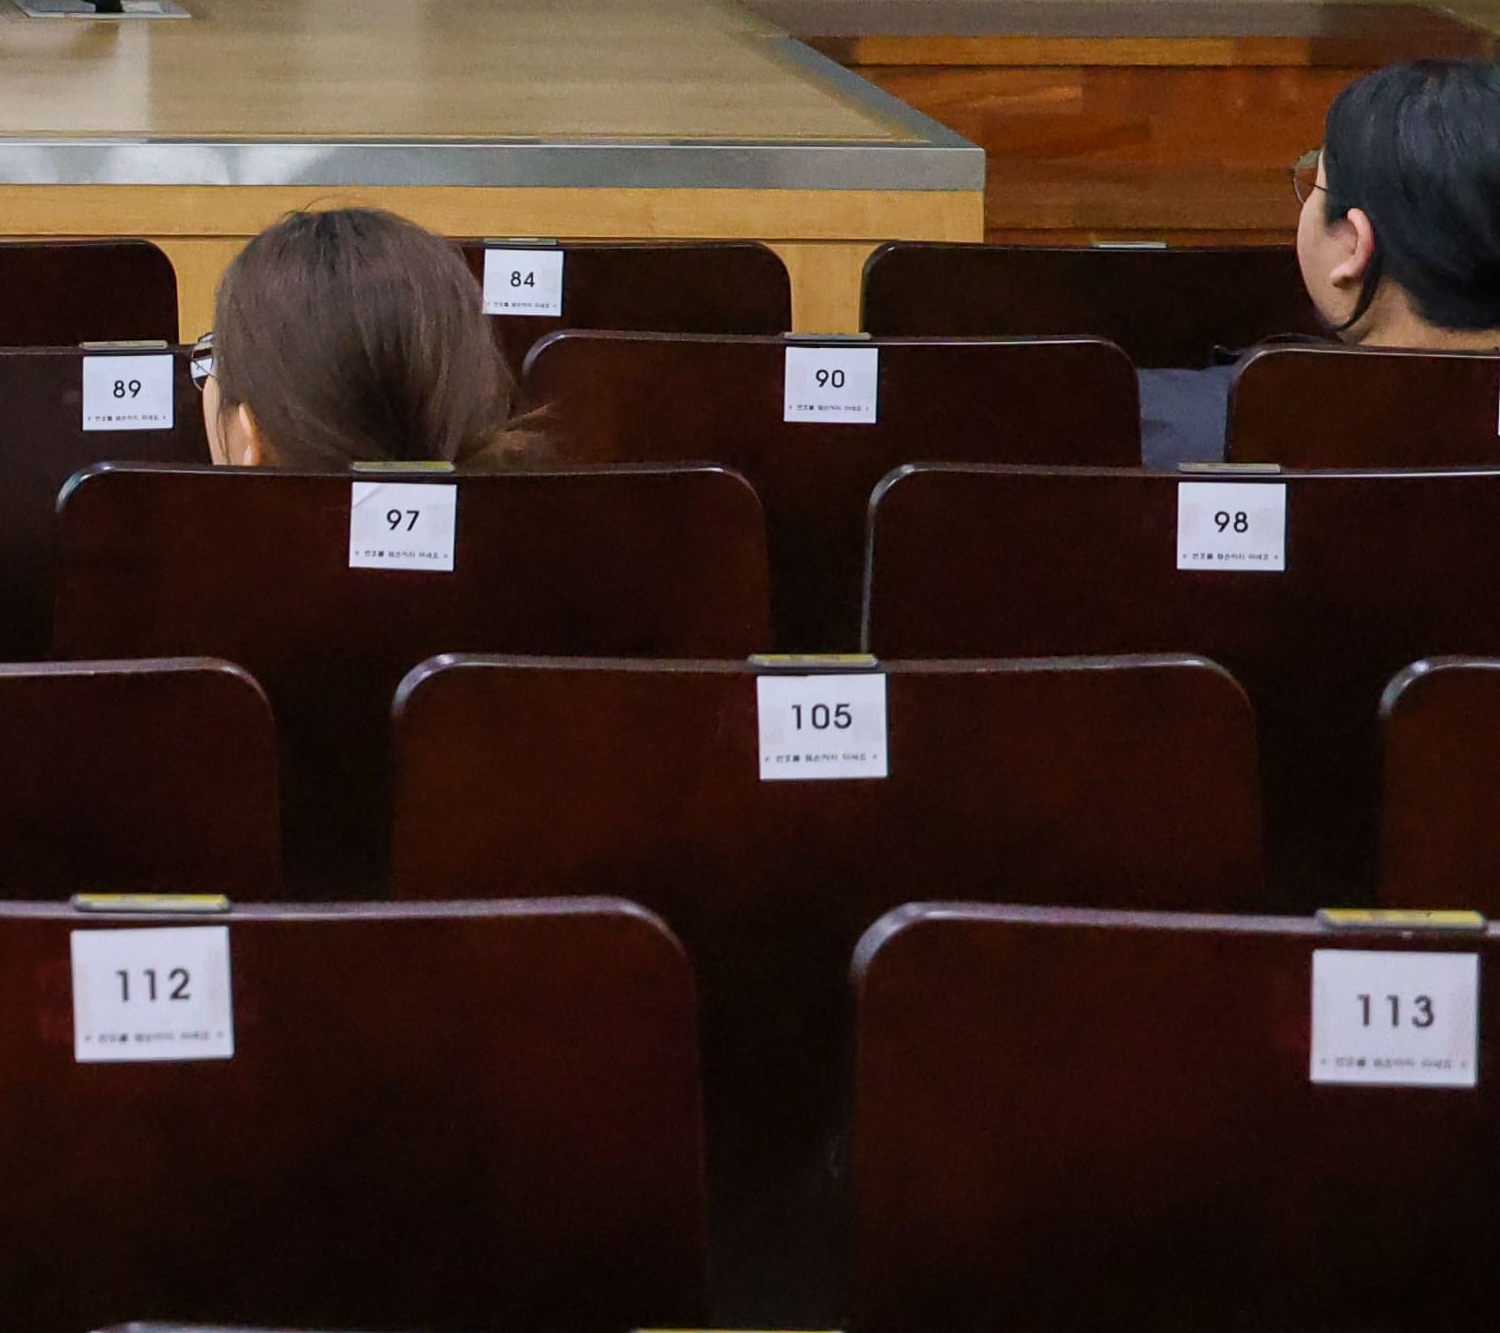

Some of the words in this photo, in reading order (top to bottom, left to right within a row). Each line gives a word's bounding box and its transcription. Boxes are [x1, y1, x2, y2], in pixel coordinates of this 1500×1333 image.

[510, 271, 535, 287] 84
[113, 380, 141, 398] 89
[815, 369, 845, 388] 90
[386, 509, 419, 531] 97
[1214, 511, 1248, 533] 98
[792, 703, 852, 730] 105
[117, 968, 190, 1002] 112
[1358, 995, 1435, 1029] 113
